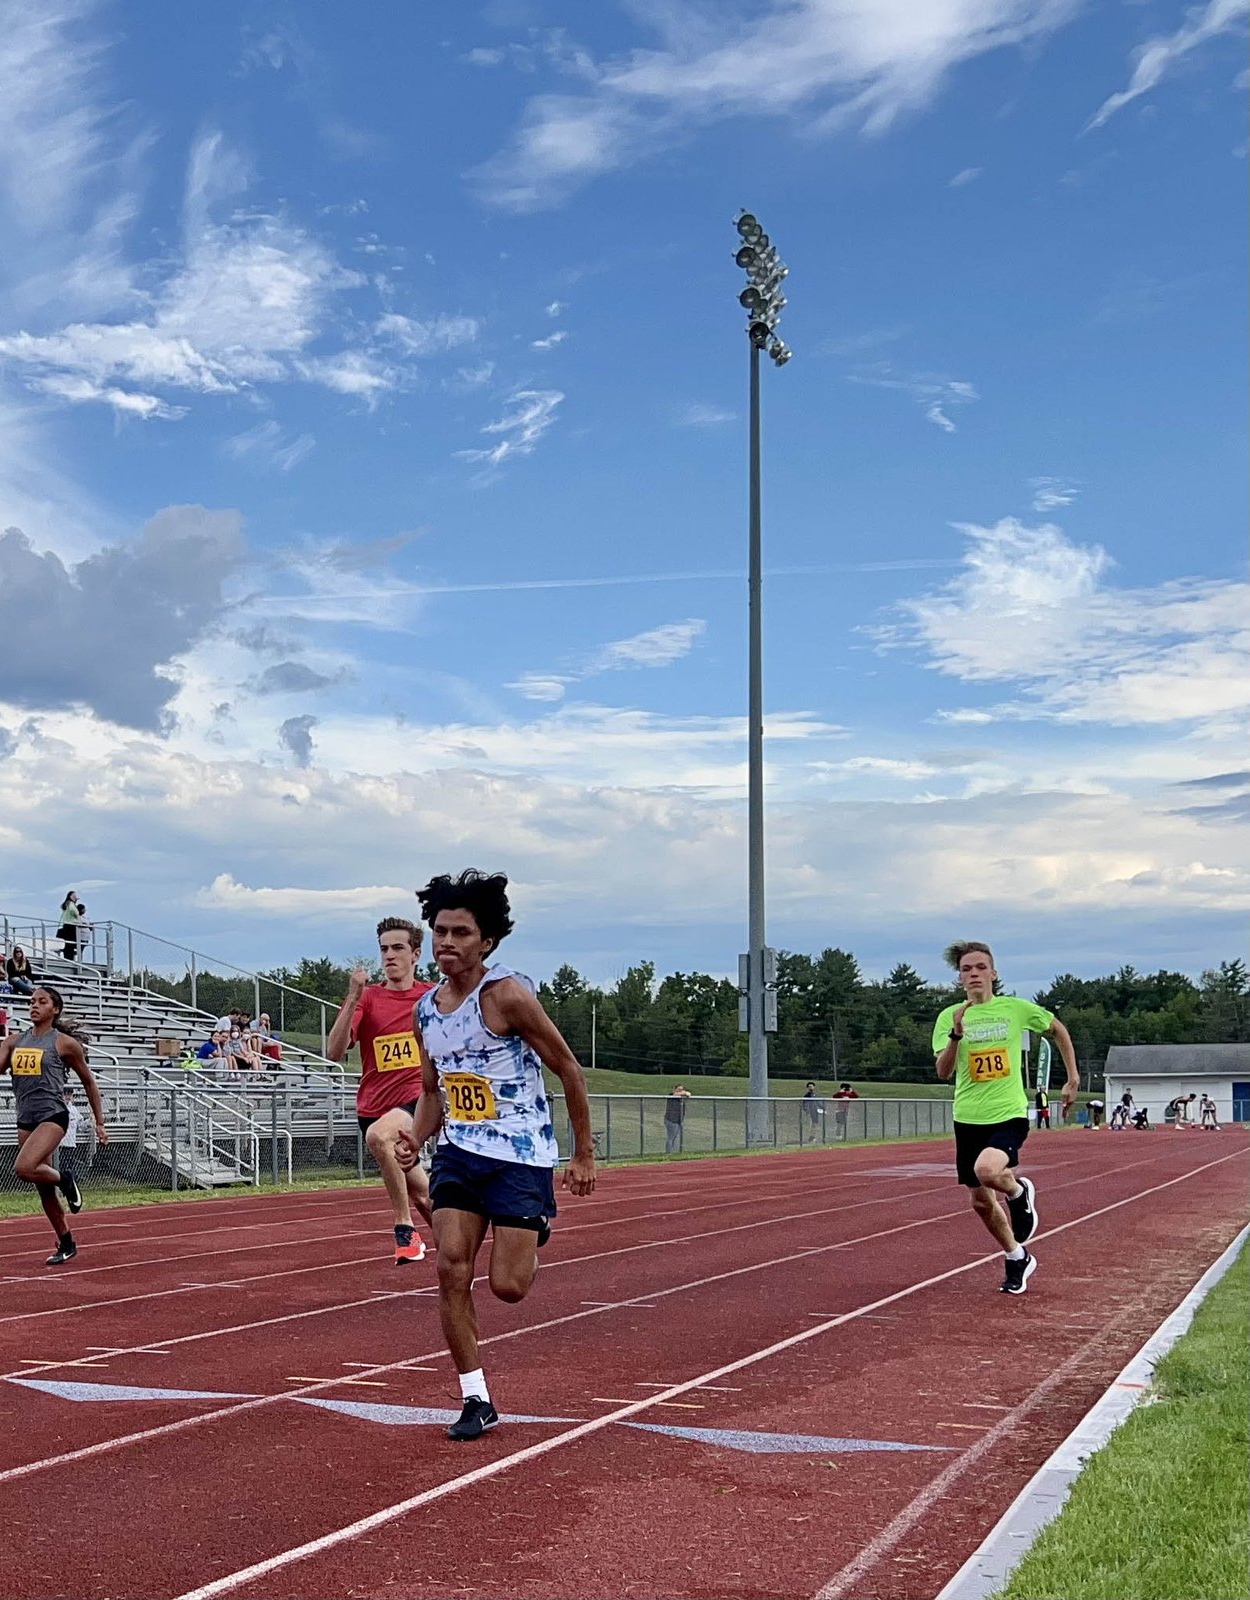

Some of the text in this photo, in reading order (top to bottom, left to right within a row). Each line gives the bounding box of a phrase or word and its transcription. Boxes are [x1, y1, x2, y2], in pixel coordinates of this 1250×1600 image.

[16, 1054, 36, 1069] 273
[381, 1040, 412, 1062] 244
[974, 1055, 1003, 1074] 218
[1036, 1052, 1046, 1092] STAR
[451, 1085, 486, 1111] 285
